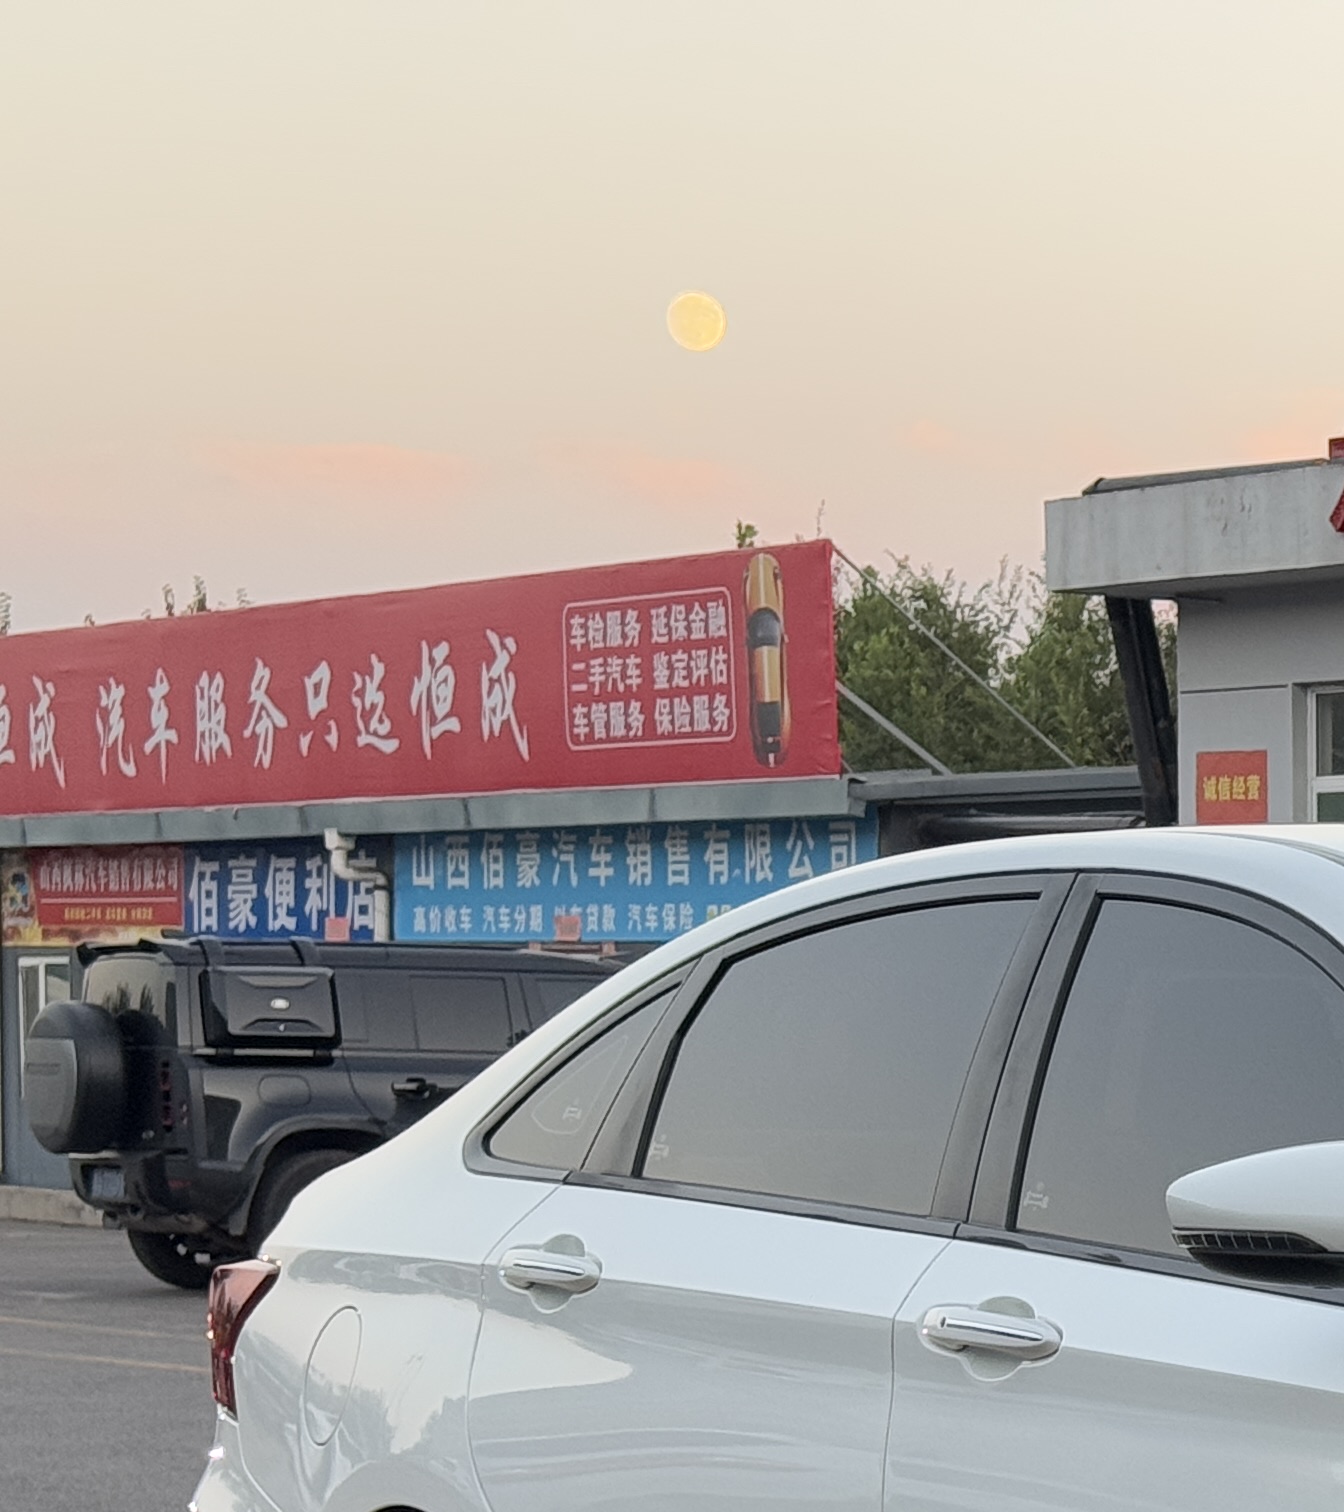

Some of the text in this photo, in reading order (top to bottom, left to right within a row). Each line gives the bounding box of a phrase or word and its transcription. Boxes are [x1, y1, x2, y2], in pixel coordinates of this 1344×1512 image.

[570, 599, 727, 652] 车检服务 延保金融
[571, 645, 728, 696] 二手汽车 鉴定评估
[572, 693, 730, 742] 车管服务 保险服务
[1203, 774, 1260, 802] 诚信经营
[412, 820, 857, 891] 山西佰豪汽车销售有限公司
[189, 848, 377, 934] 佰豪便利店
[413, 904, 473, 934] 高价收车
[483, 903, 543, 934] 汽车分期
[628, 902, 694, 933] 汽车保险
